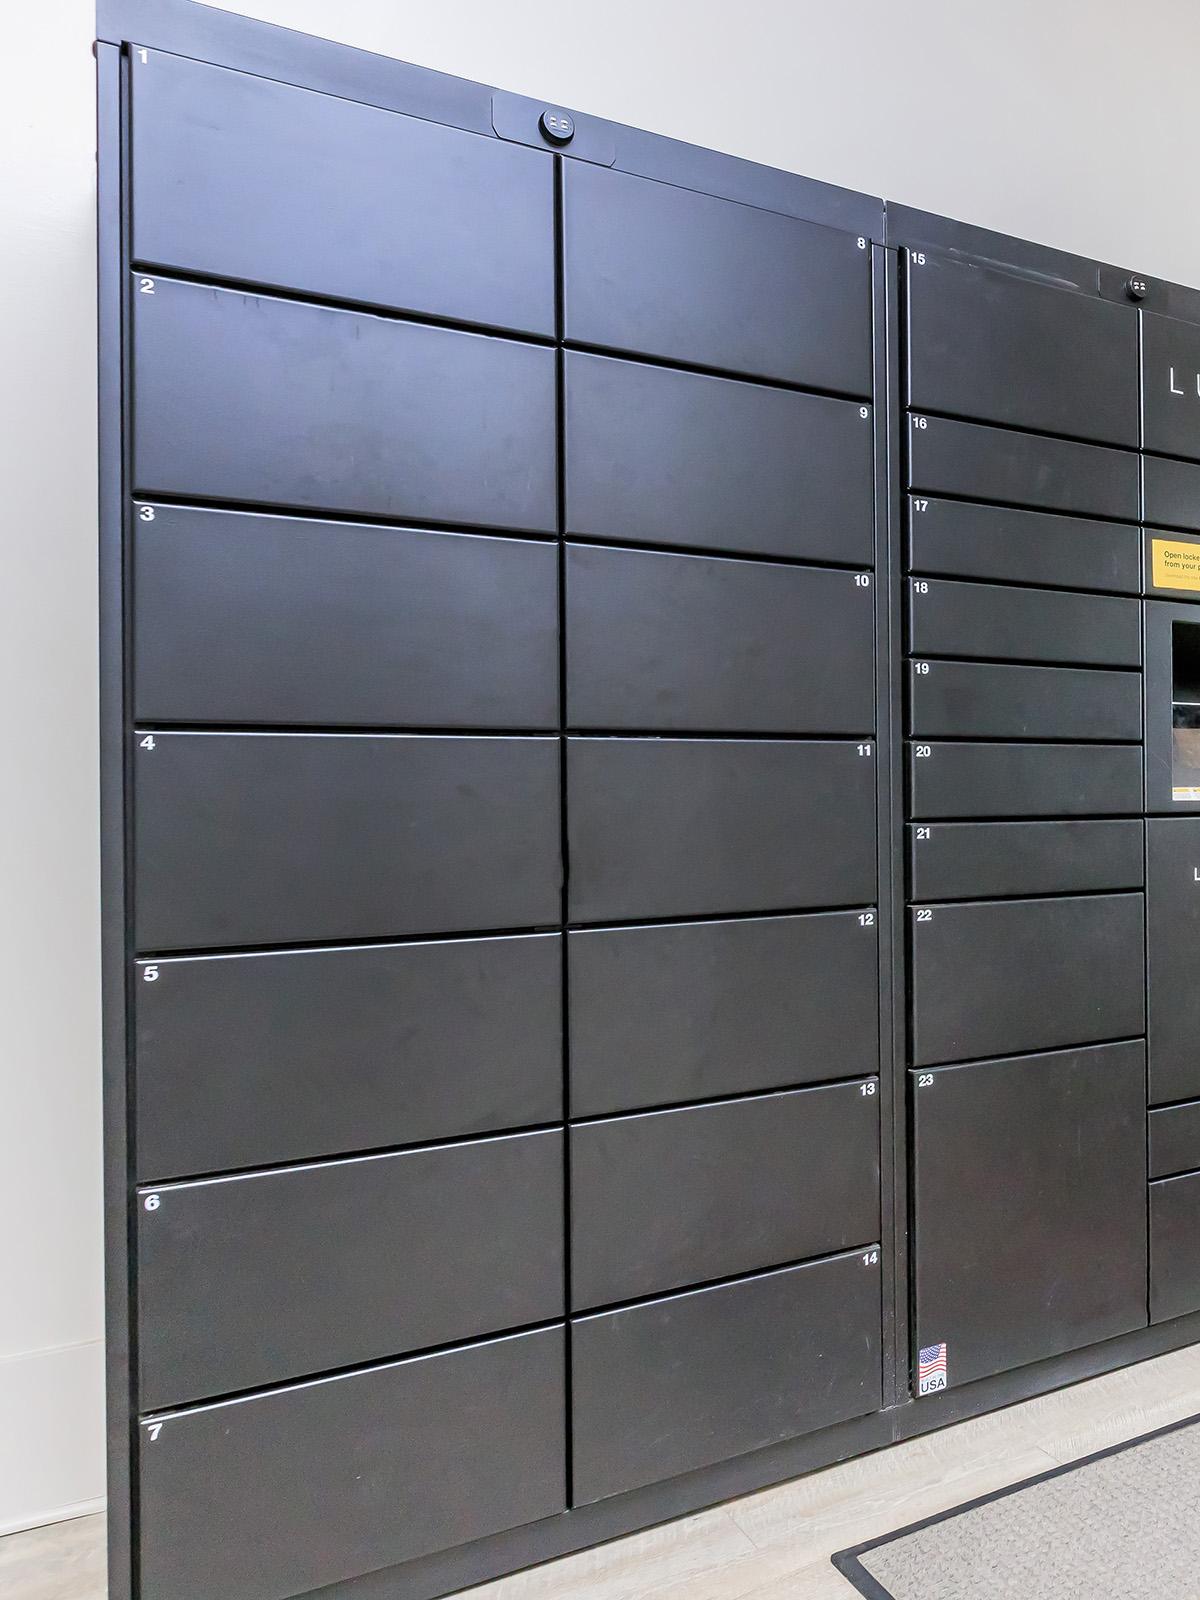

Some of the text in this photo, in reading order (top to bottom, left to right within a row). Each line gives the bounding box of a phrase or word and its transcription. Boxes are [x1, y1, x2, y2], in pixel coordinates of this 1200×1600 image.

[138, 50, 147, 63] 1
[857, 238, 865, 249] 8
[912, 252, 925, 265] 15
[141, 279, 154, 294] 2
[860, 407, 868, 418] 9
[913, 417, 927, 429] 16
[914, 500, 928, 511] 17
[140, 507, 154, 521] 3
[1164, 550, 1182, 559] Open
[1164, 560, 1181, 568] from
[855, 575, 869, 586] 10
[914, 582, 928, 593] 18
[915, 663, 929, 674] 19
[140, 736, 155, 750] 4
[857, 745, 870, 755] 11
[916, 746, 930, 757] 20
[917, 828, 929, 839] 21
[858, 914, 873, 925] 12
[917, 910, 932, 921] 22
[144, 966, 158, 981] 5
[919, 1074, 933, 1087] 23
[860, 1083, 875, 1096] 13
[144, 1195, 160, 1210] 6
[863, 1252, 877, 1265] 14
[921, 1377, 945, 1393] USA
[147, 1423, 163, 1441] 7
